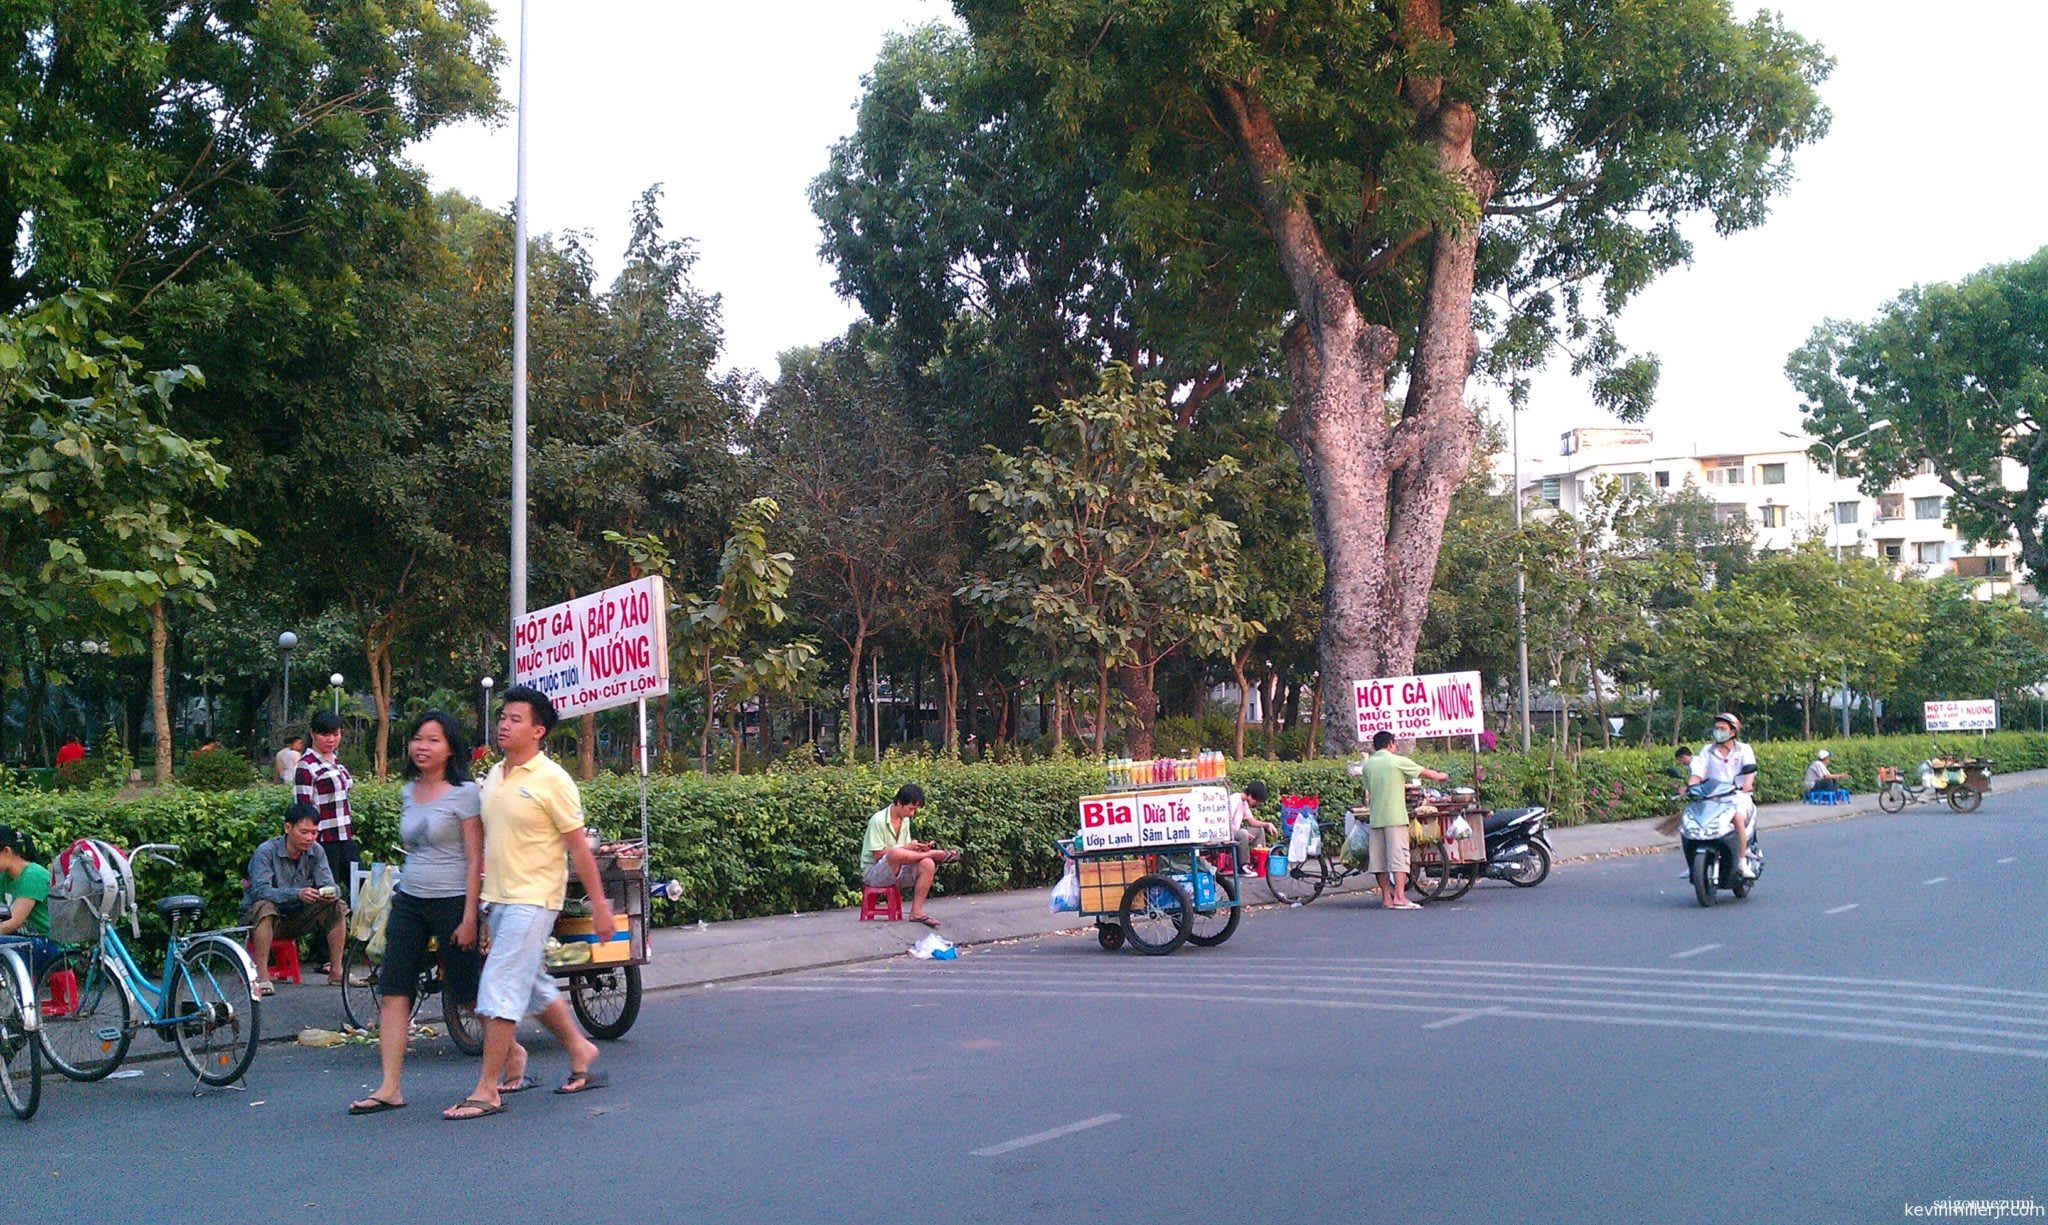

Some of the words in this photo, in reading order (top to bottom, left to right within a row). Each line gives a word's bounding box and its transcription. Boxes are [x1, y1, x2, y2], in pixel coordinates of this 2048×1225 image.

[516, 615, 547, 649] HỘT
[552, 604, 574, 636] GÀ
[588, 591, 615, 638] BẮP
[620, 587, 649, 630] XÀO
[589, 632, 650, 681] NƯỚNG
[572, 688, 598, 707] LỘN
[603, 679, 627, 698] CÚT
[631, 674, 656, 694] LỘN
[1357, 681, 1394, 710] HỘT
[1402, 678, 1428, 705] GÀ
[1083, 802, 1132, 828] Bia
[1143, 803, 1166, 824] Dừa
[1168, 798, 1190, 822] Tắc
[1108, 833, 1133, 846] Lạnh
[1142, 828, 1163, 841] Sâm
[1166, 826, 1190, 842] Lạnh
